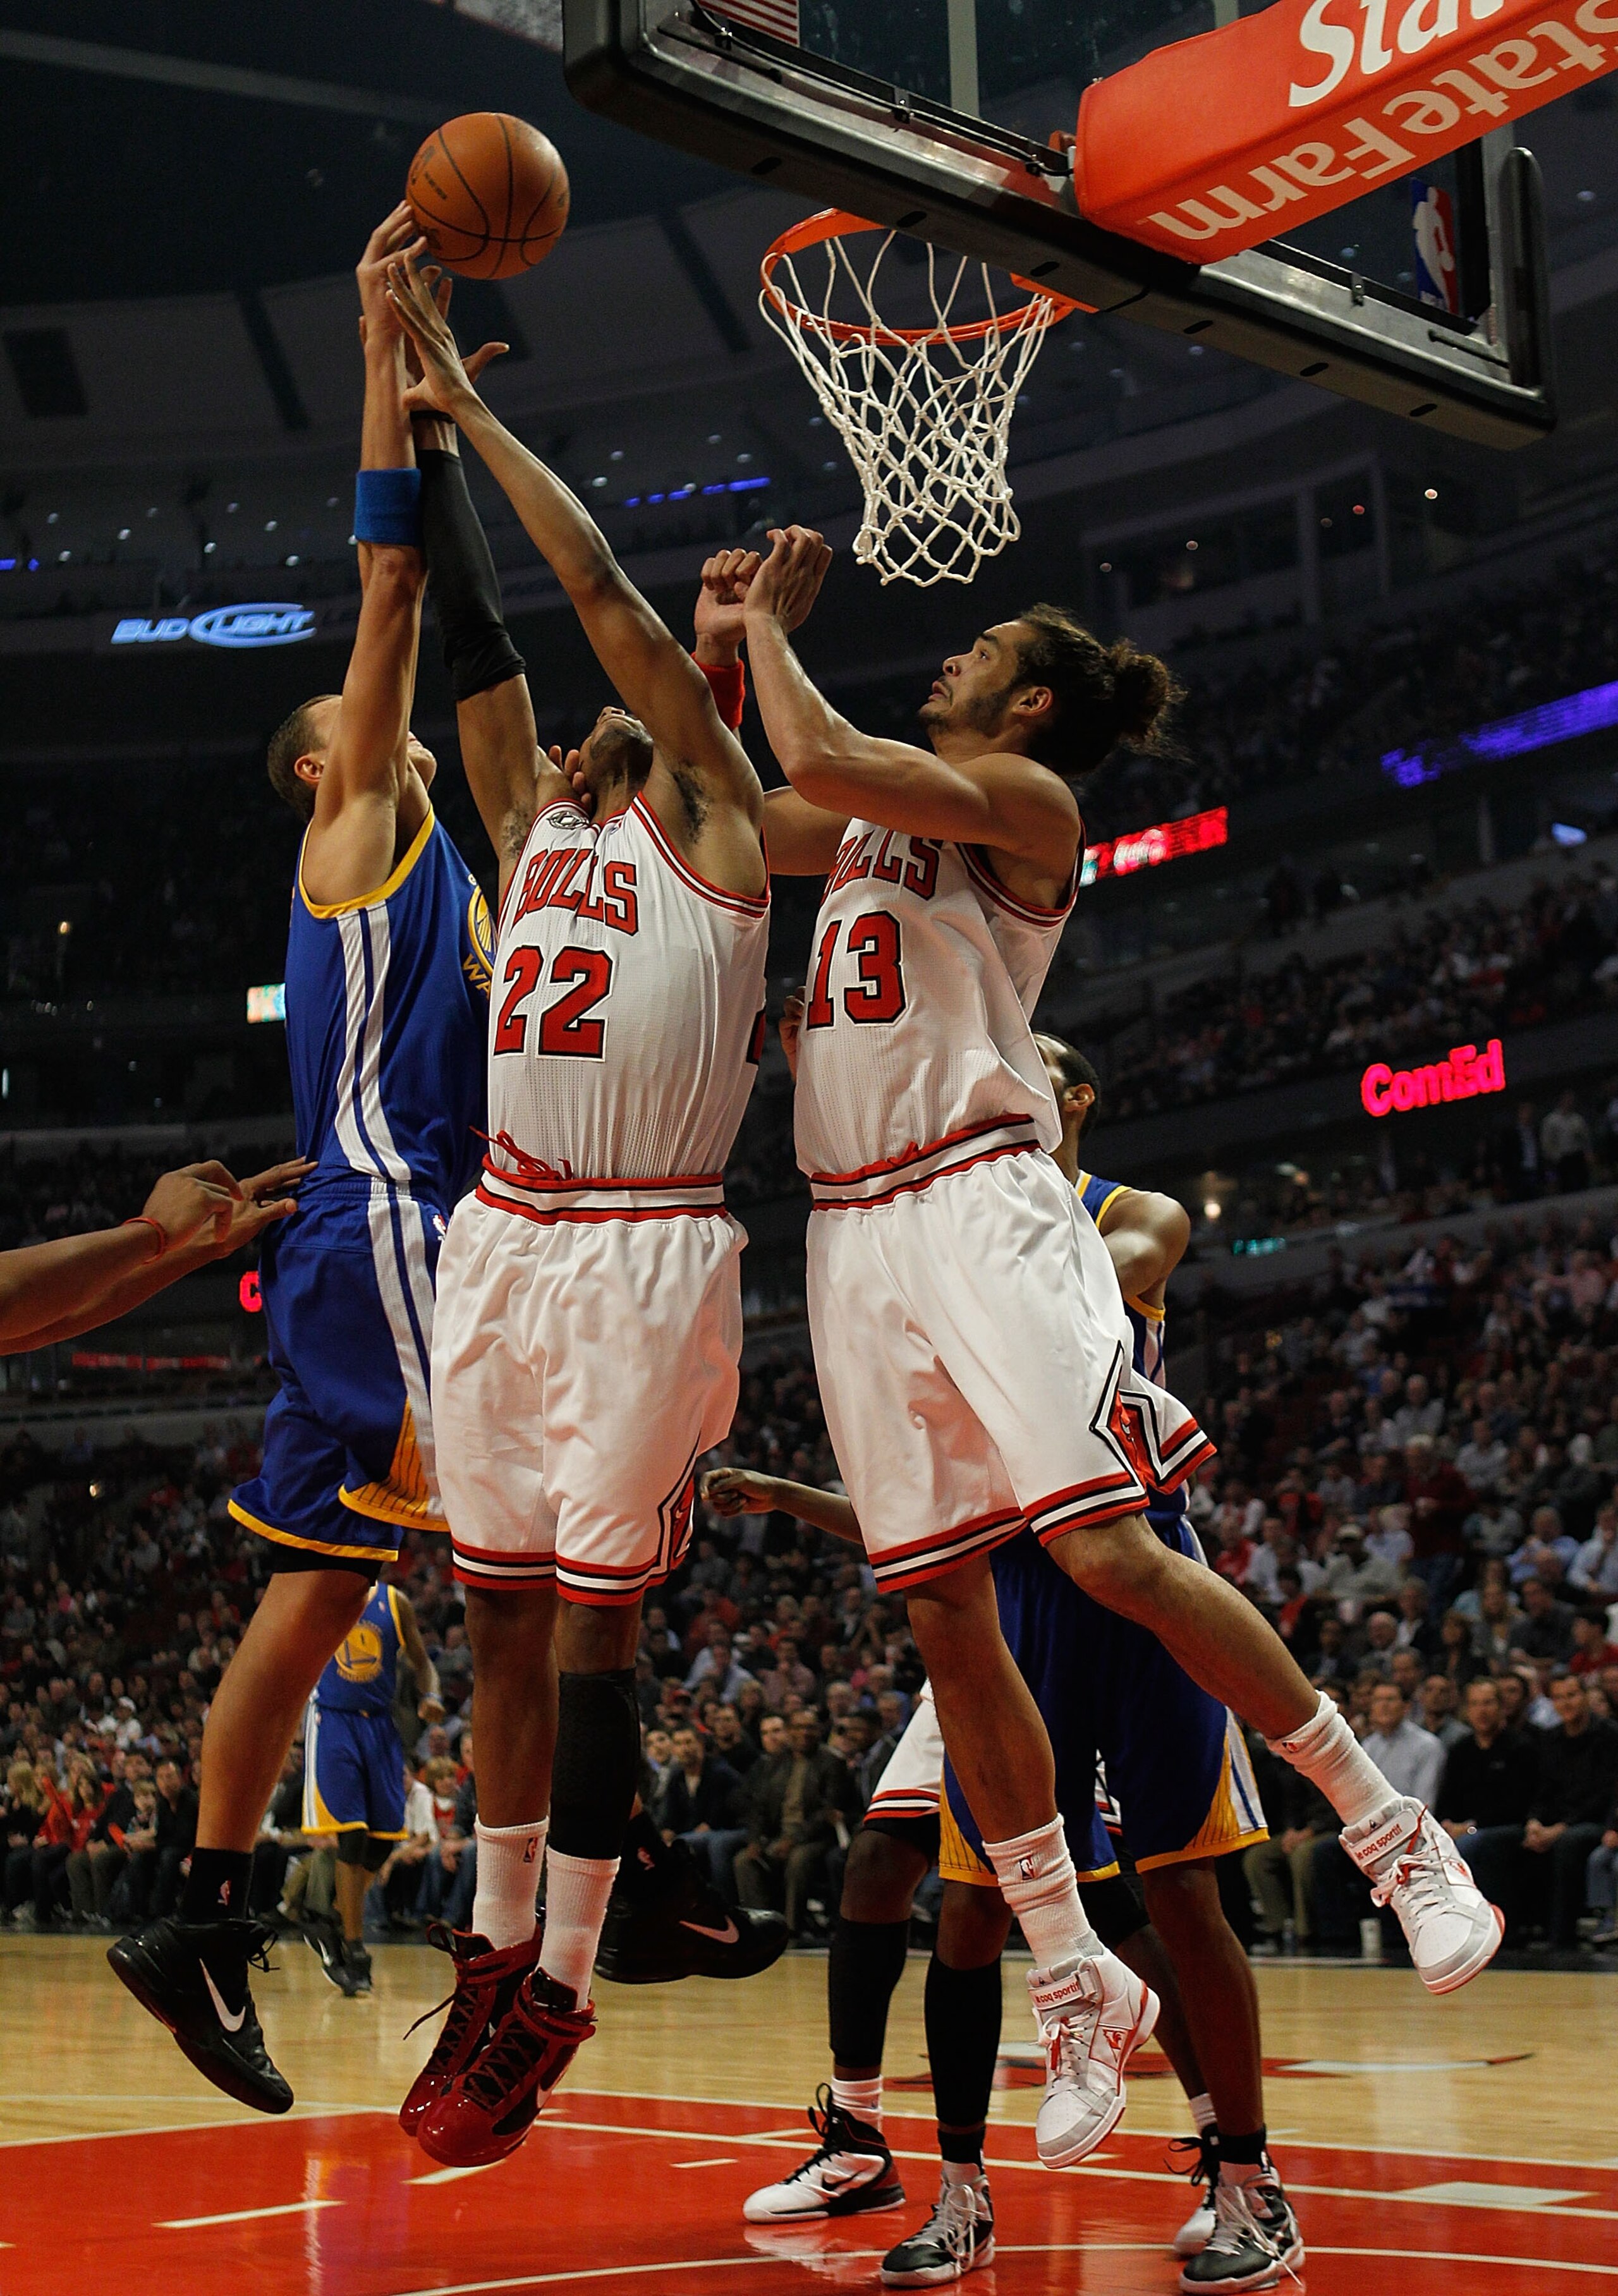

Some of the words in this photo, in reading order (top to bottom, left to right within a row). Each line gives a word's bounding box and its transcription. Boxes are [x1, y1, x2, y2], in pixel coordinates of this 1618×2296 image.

[111, 618, 190, 644] BUD
[209, 610, 315, 635] LIGHT
[513, 848, 639, 937] BULLS
[493, 945, 614, 1060] 22
[806, 910, 906, 1030] 13
[1361, 1038, 1506, 1117] ComEd
[1363, 1843, 1379, 1856] coq
[1377, 1823, 1402, 1847] sportif
